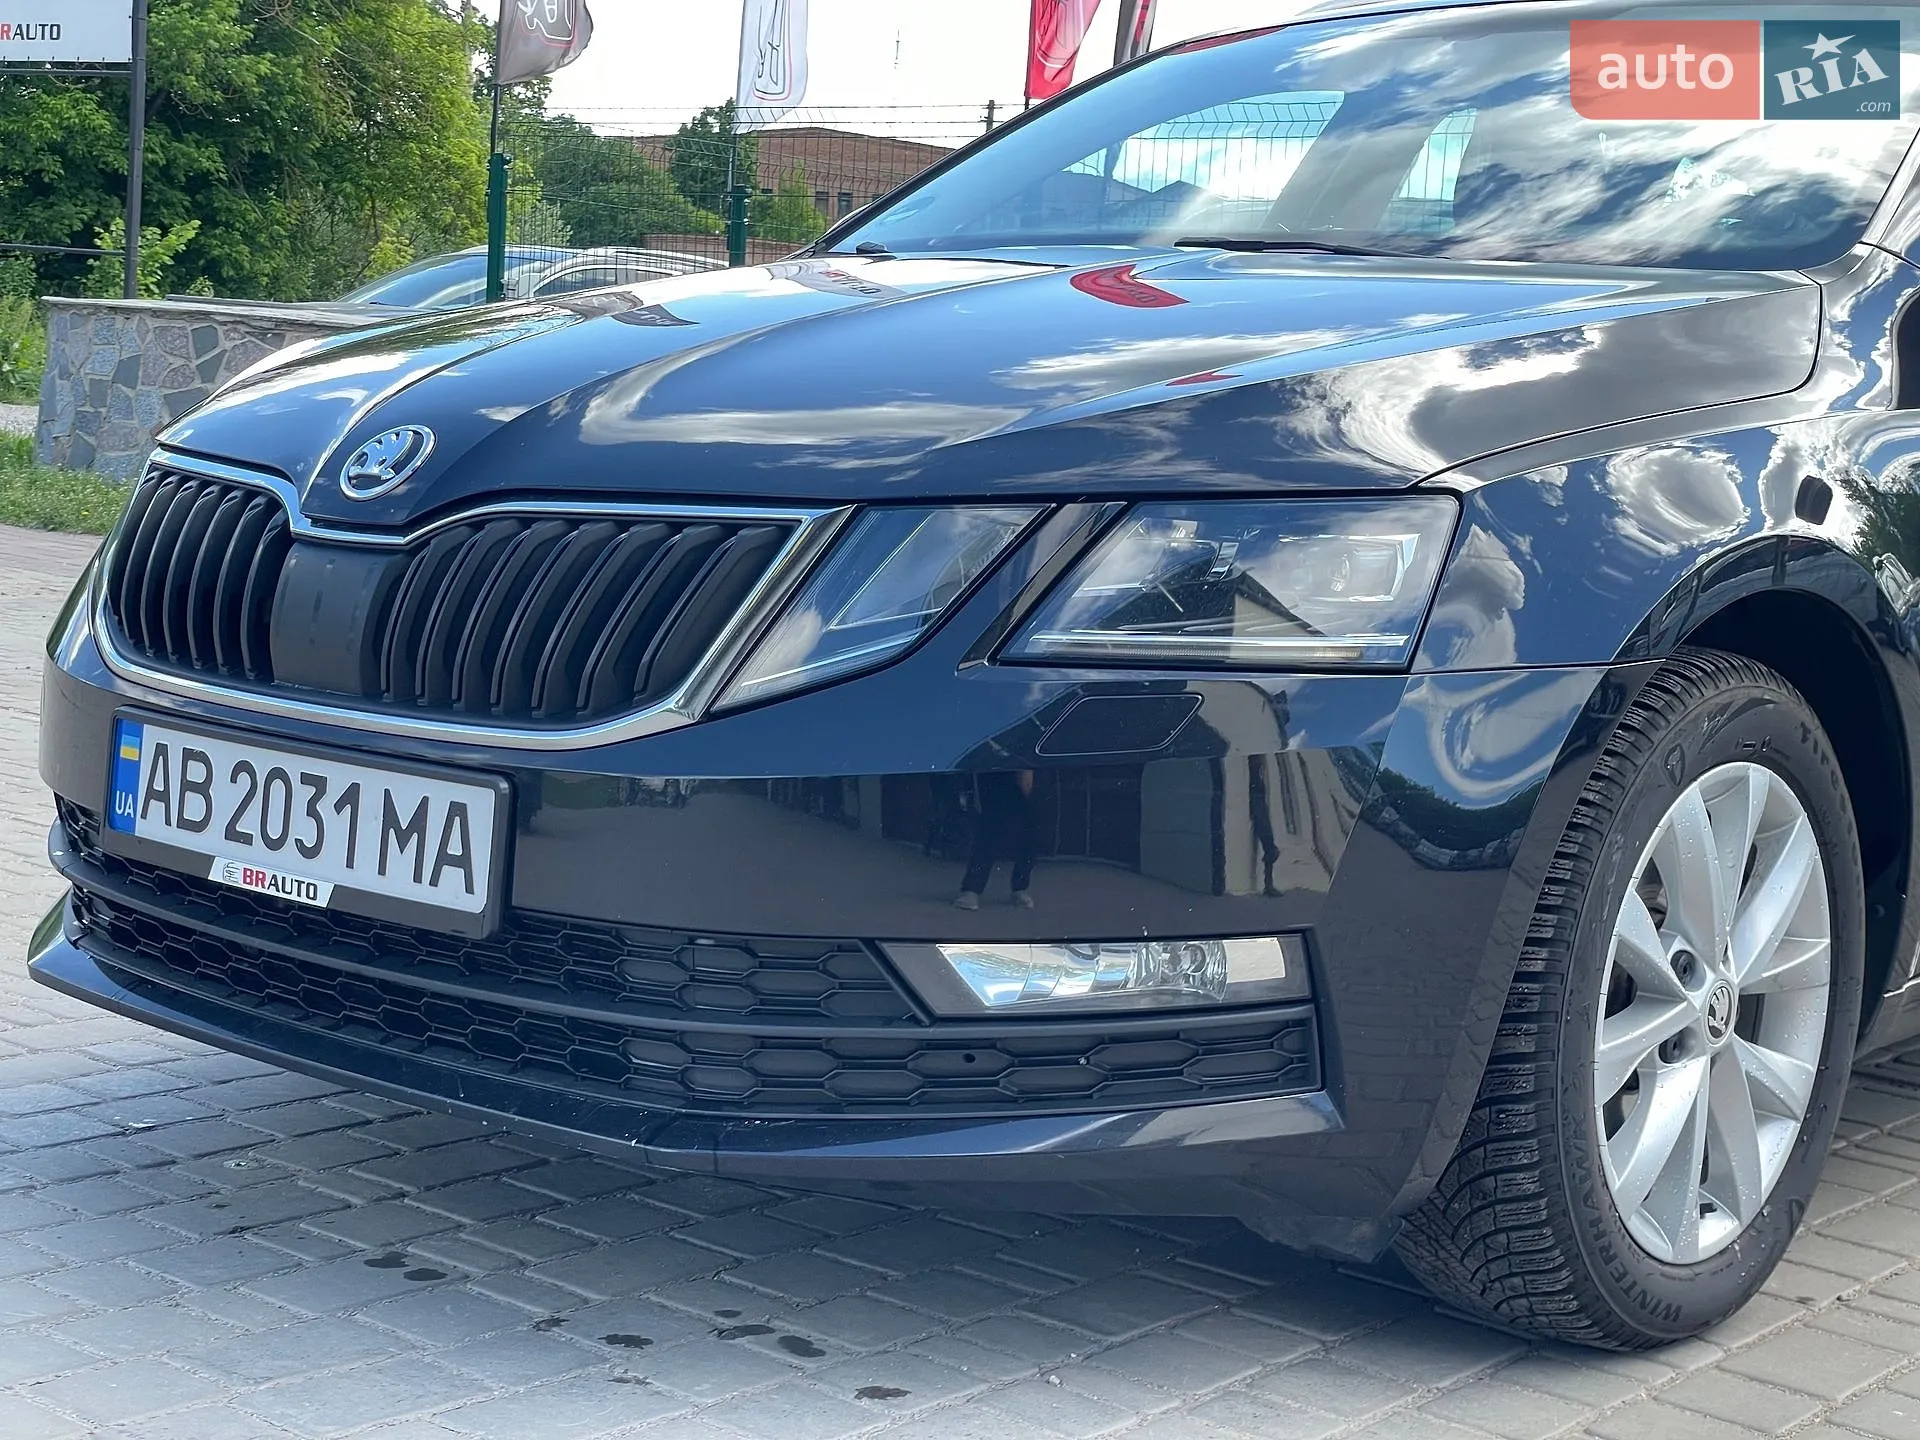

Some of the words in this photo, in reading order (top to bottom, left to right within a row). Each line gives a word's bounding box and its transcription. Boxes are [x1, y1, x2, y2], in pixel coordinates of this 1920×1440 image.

[115, 790, 134, 819] UA
[140, 742, 214, 833] AB
[224, 760, 361, 869] 2031
[377, 788, 475, 895] MA
[242, 867, 318, 901] BRAUTO
